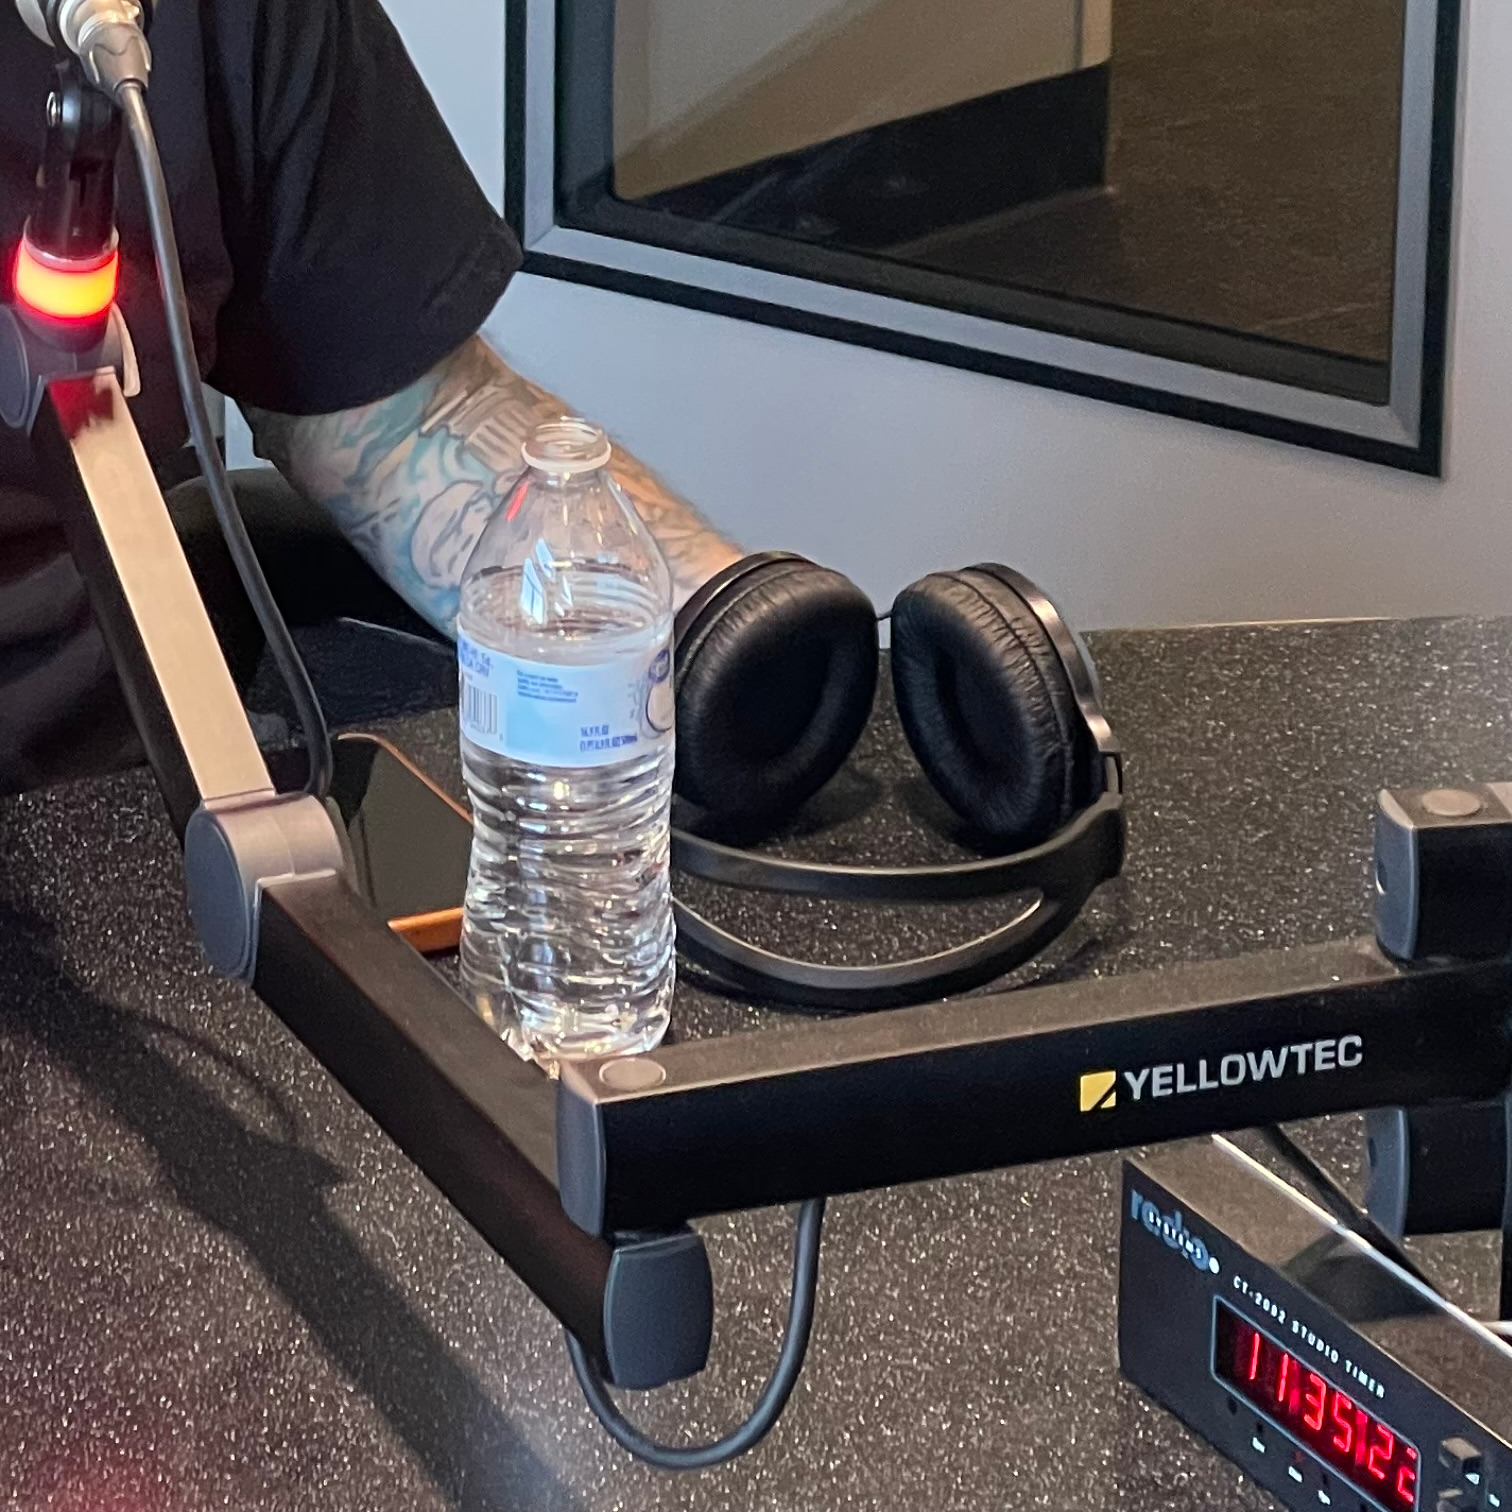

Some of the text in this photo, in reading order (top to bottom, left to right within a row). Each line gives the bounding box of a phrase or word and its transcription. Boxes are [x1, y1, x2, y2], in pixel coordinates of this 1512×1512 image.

[1124, 1035, 1363, 1100] YELLOWTEC
[1292, 1320, 1339, 1364] STUDIO
[1345, 1359, 1385, 1399] TIMER
